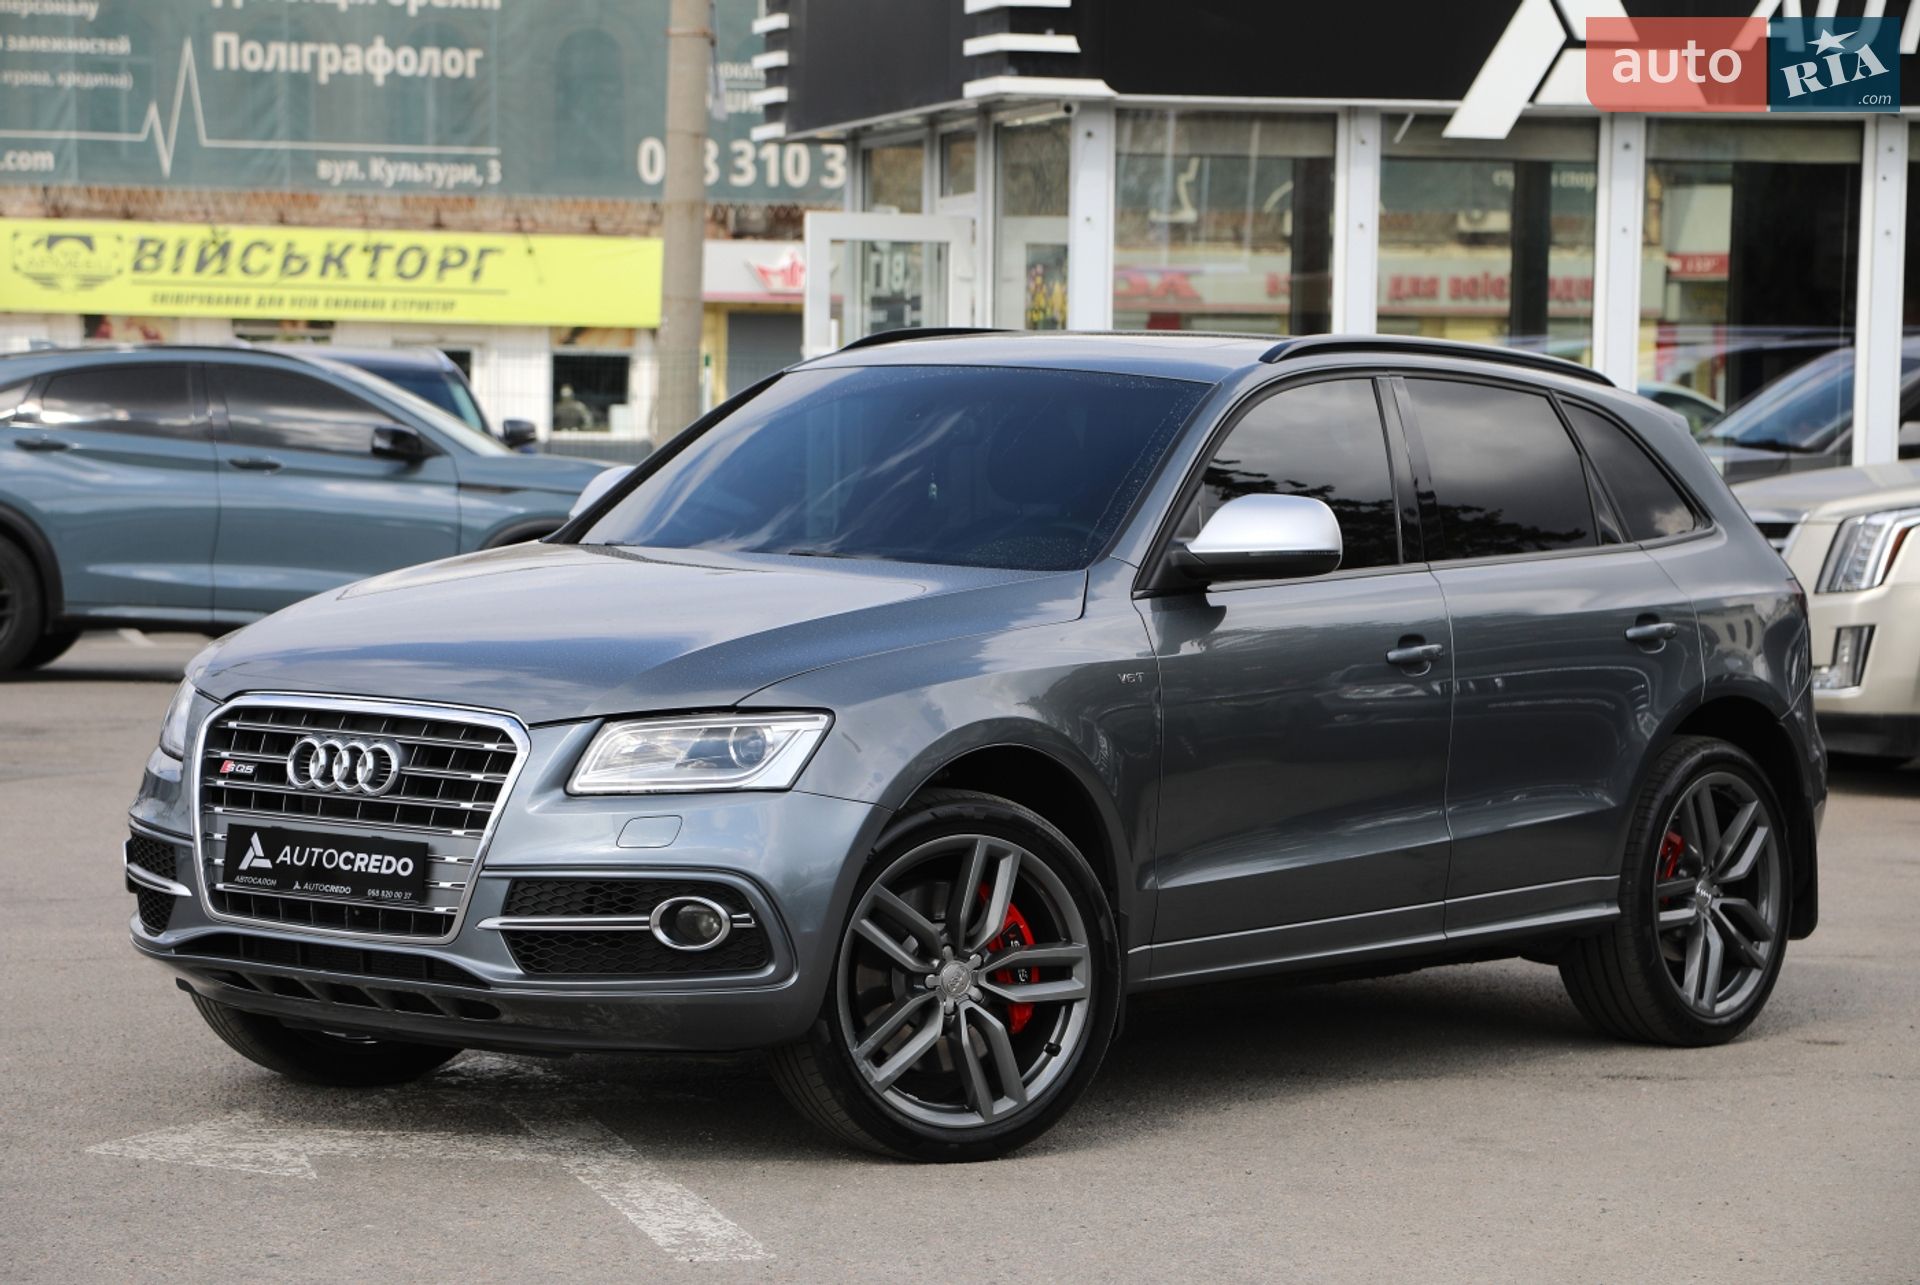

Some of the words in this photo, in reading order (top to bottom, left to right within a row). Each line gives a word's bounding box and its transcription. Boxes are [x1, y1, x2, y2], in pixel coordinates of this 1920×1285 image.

[213, 32, 483, 85] Поліграфолог
[317, 158, 366, 187] вул.
[369, 158, 485, 190] Культури,
[132, 237, 503, 283] ВІЙСЬКТОРГ
[276, 845, 414, 877] AUTOCREDO
[302, 882, 353, 895] AUTOCREDO
